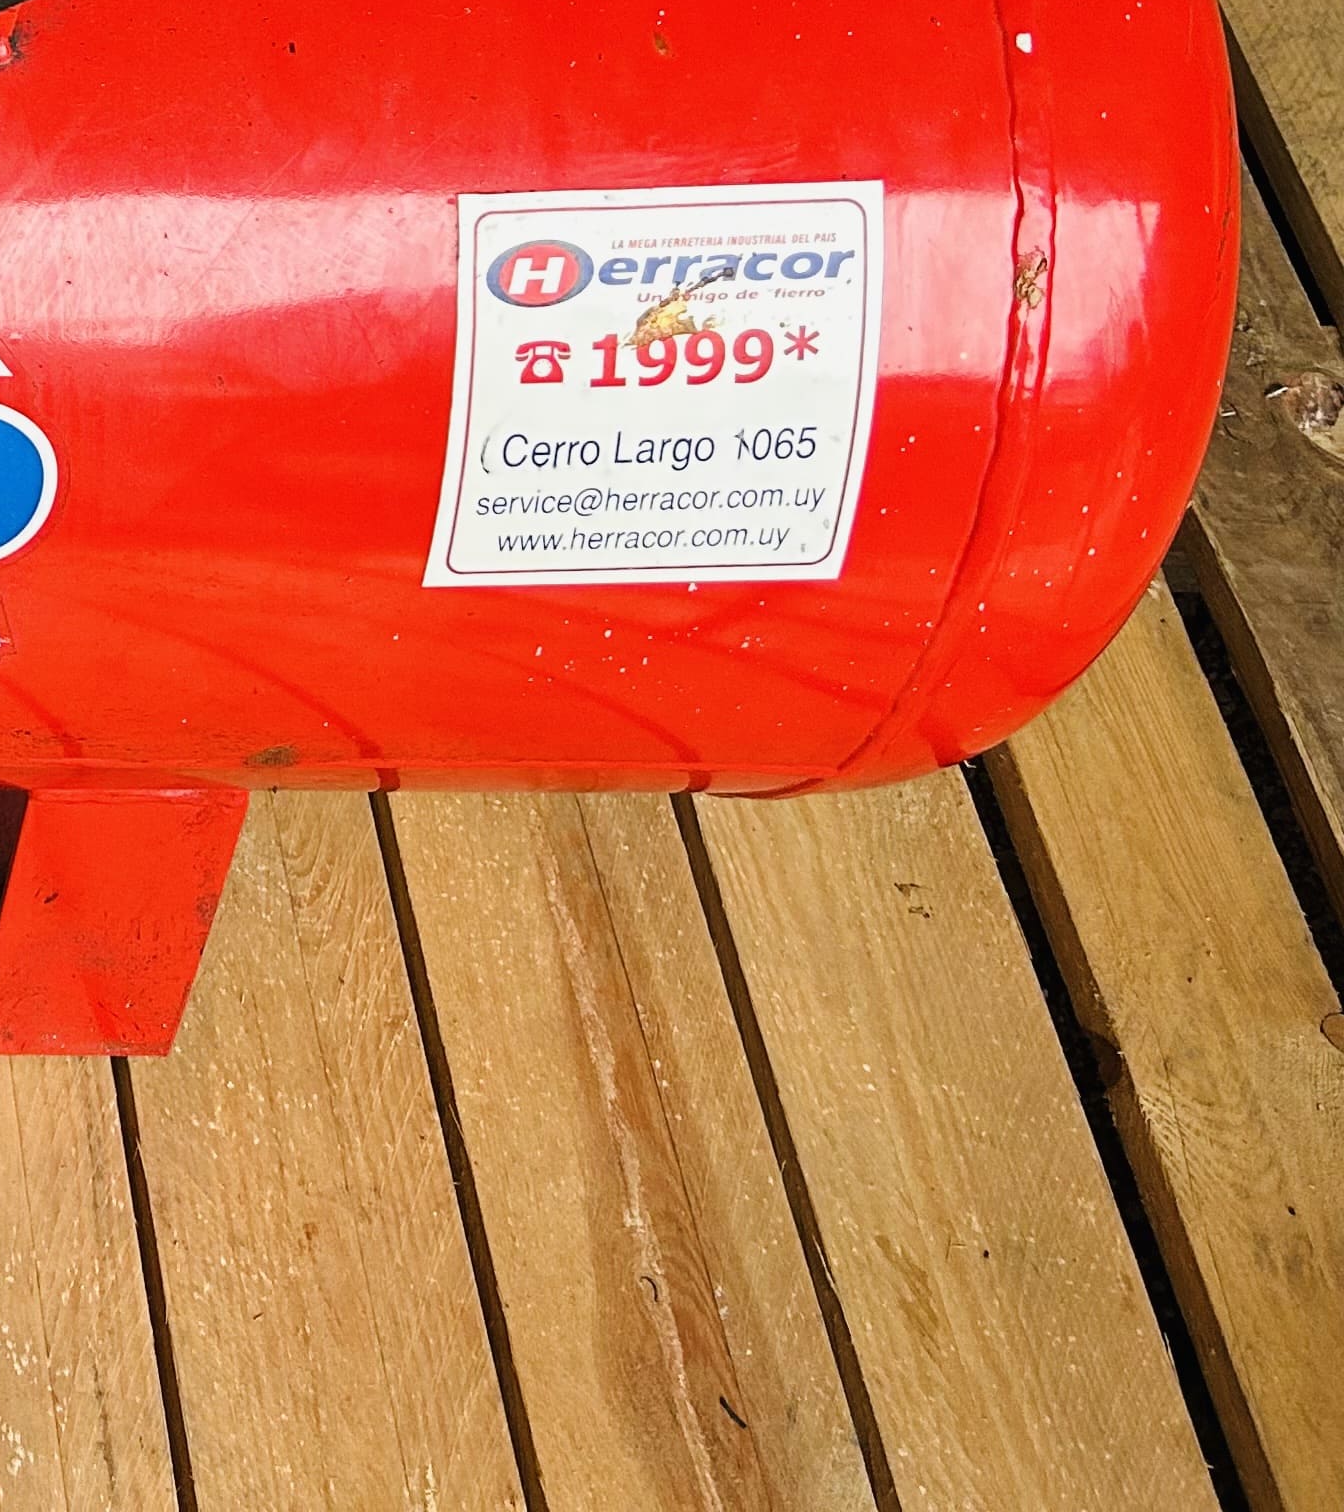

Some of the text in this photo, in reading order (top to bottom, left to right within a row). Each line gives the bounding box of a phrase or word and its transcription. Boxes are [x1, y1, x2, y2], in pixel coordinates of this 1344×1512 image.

[611, 232, 837, 250] LA MEGA FERRETERIA INDUSTRIAL DEL PAIS
[492, 246, 855, 302] Herracor
[636, 292, 663, 303] Un
[736, 289, 760, 300] de
[502, 433, 601, 469] Cerro
[614, 431, 715, 471] Largo
[476, 487, 826, 518] service@herracor.com.uy
[497, 527, 791, 552] www.herracor.com.uy
